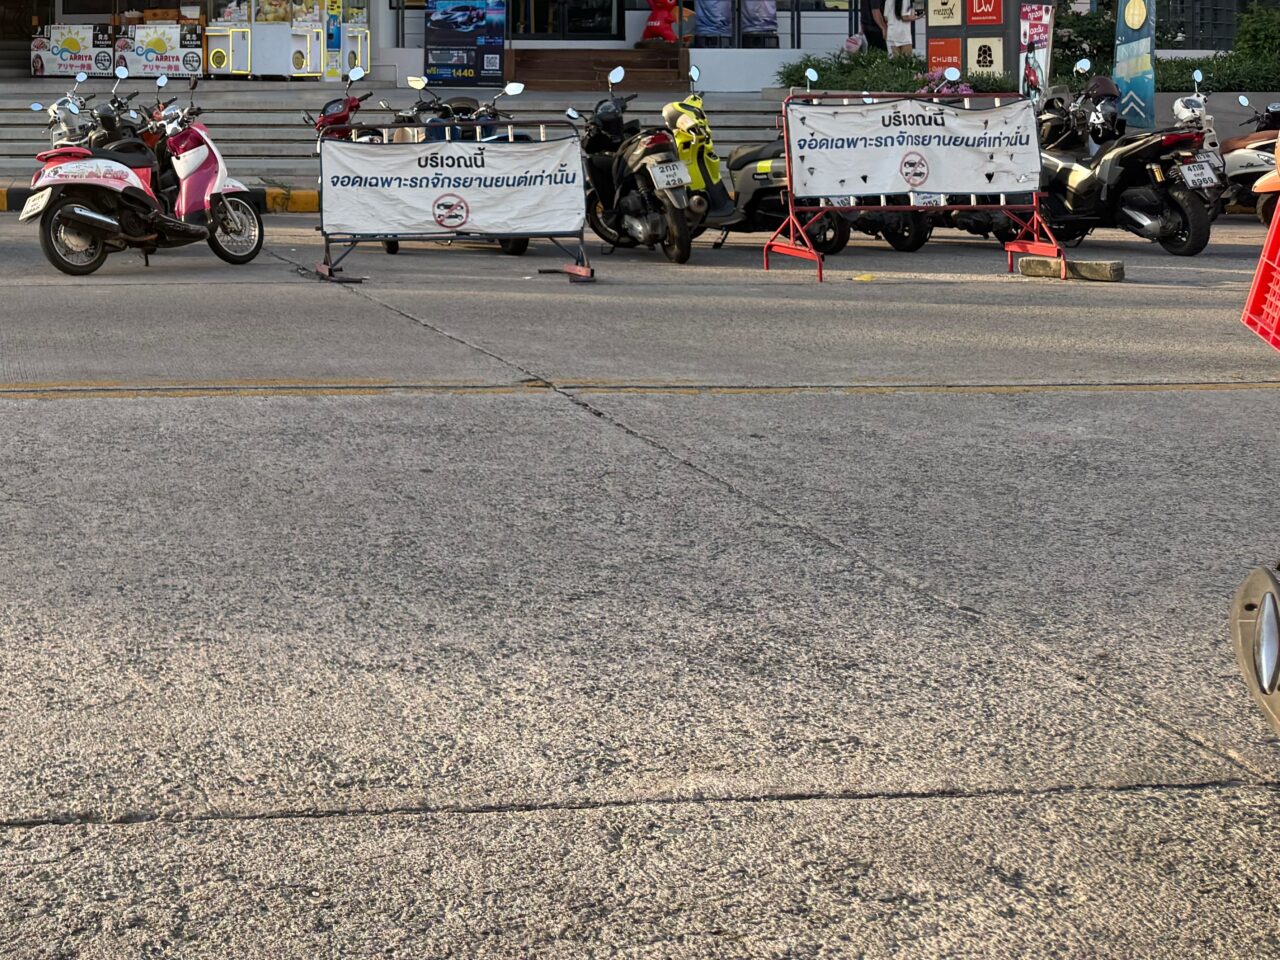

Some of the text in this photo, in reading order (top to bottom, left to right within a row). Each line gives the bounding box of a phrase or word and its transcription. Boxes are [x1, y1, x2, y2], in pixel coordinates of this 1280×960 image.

[69, 54, 93, 62] ARRIYA
[417, 147, 486, 169] บริเวณนี้
[330, 163, 576, 189] จอดเฉพาะรถจักรยานยนต์เท่านั้น
